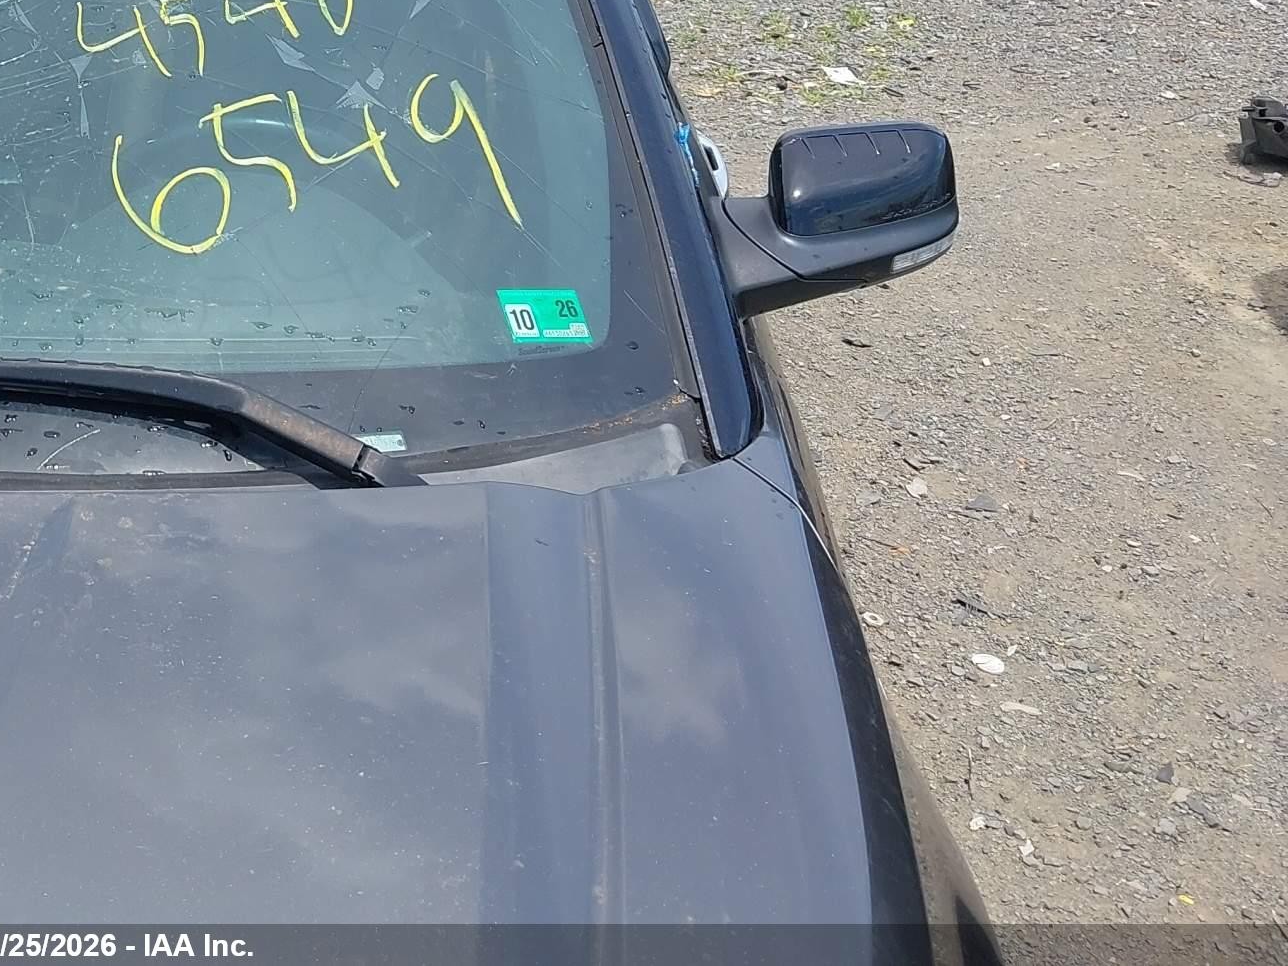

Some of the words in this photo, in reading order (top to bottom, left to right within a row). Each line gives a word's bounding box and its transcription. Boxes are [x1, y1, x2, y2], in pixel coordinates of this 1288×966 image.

[111, 72, 523, 255] 6549
[509, 308, 536, 331] 10
[555, 299, 579, 318] 26
